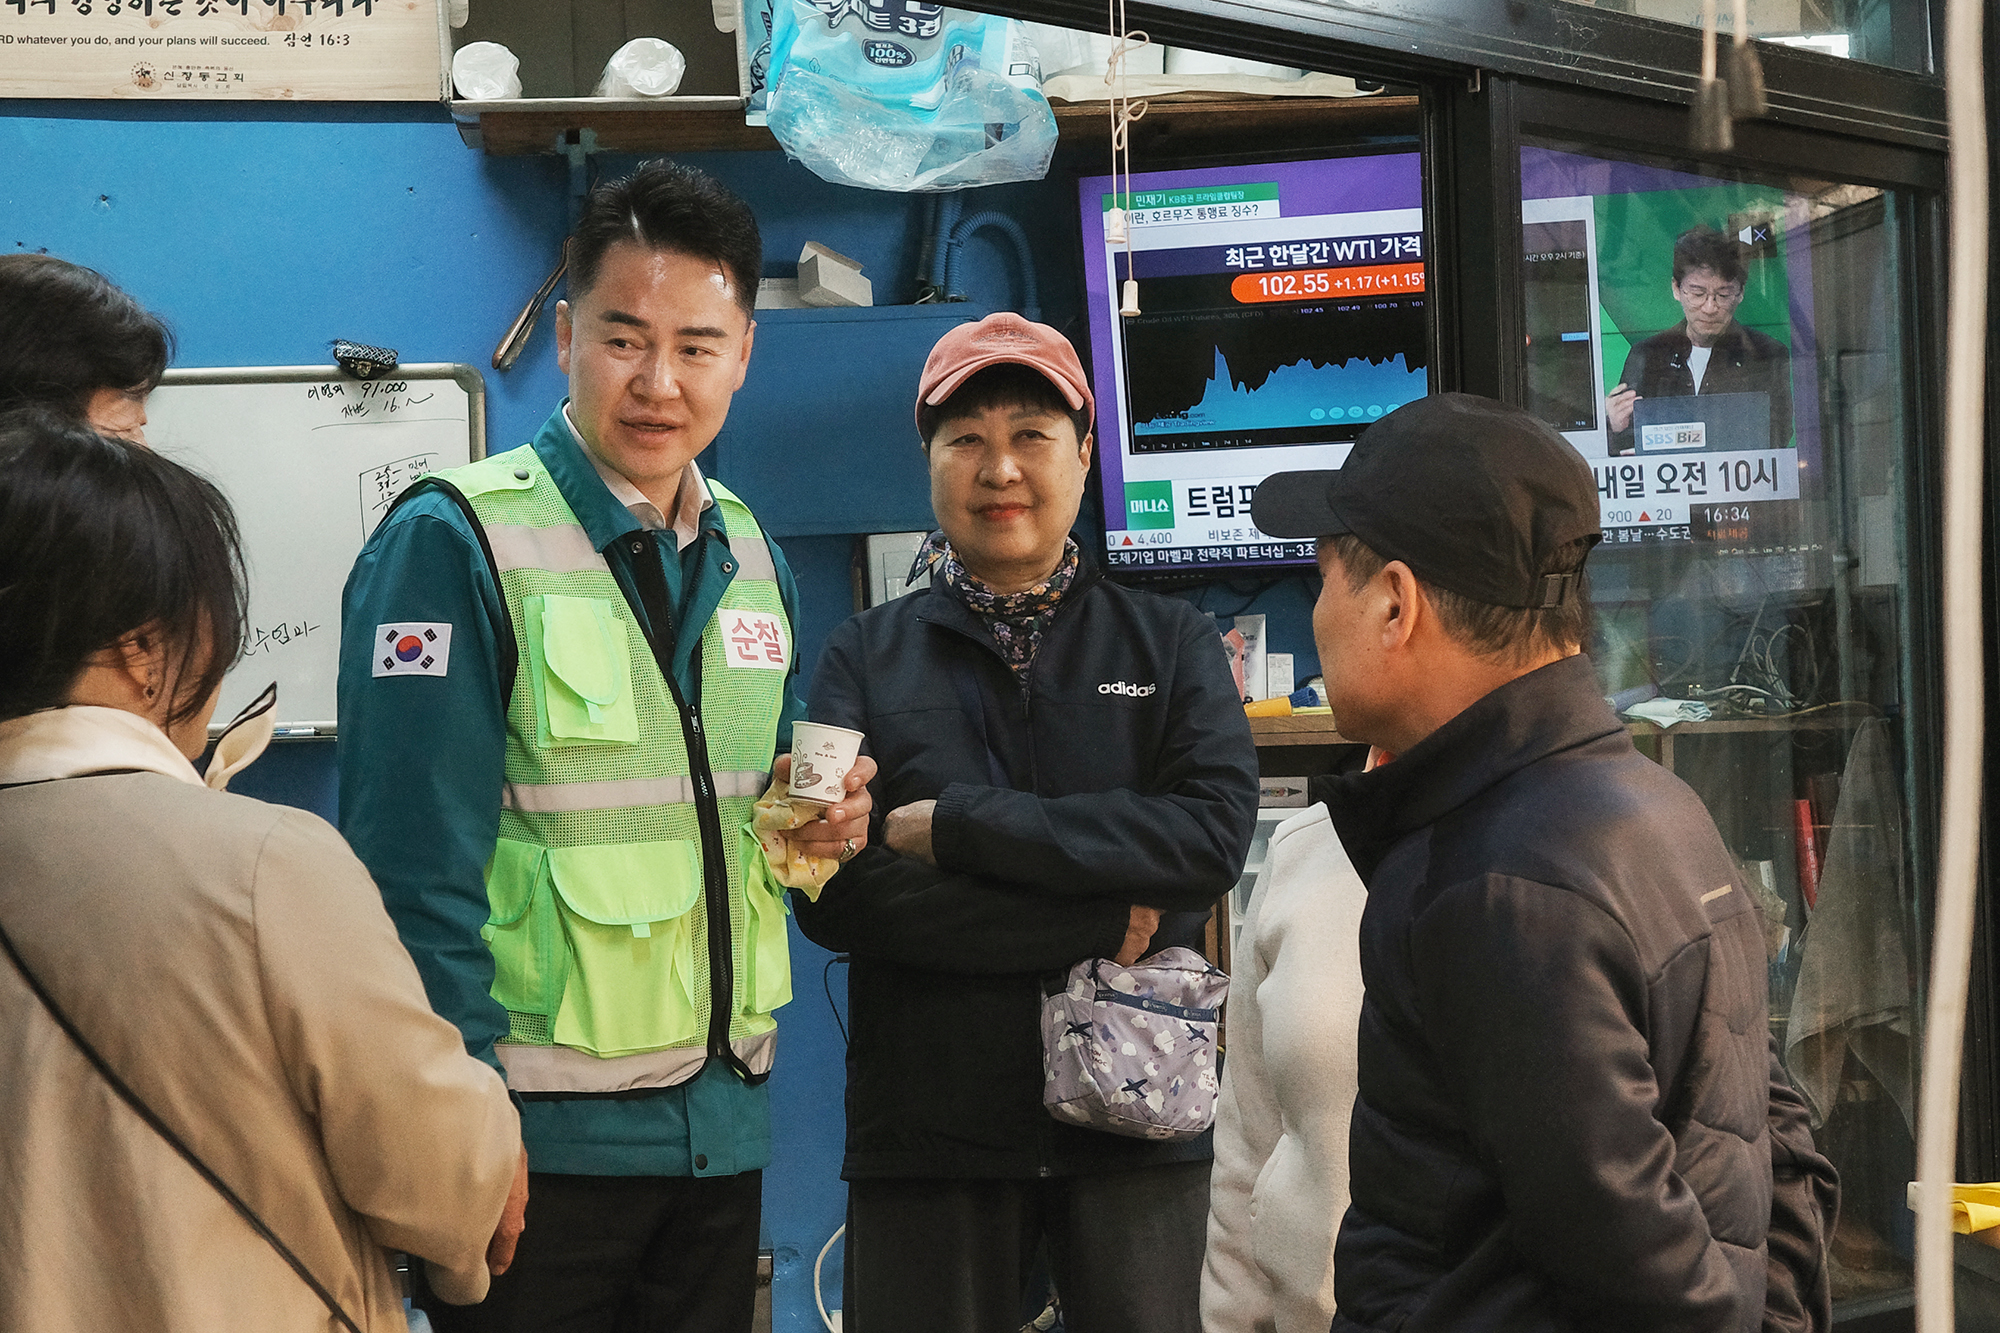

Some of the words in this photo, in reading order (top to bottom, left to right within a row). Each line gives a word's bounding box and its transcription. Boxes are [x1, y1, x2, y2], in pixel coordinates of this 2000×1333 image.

[17, 34, 67, 45] whatever
[71, 36, 91, 47] you
[94, 34, 112, 46] do,
[114, 34, 135, 45] and
[139, 36, 163, 47] your
[167, 35, 196, 47] plans
[199, 35, 218, 45] will
[221, 35, 270, 46] succeed.
[284, 32, 312, 47] 잠언
[320, 34, 350, 46] 16:3
[869, 46, 906, 60] 100%
[1135, 193, 1166, 207] 민재기
[1169, 194, 1194, 204] KB증권
[1152, 209, 1193, 222] 호르무즈
[1197, 206, 1228, 221] 통행료
[1231, 204, 1259, 218] 징수?
[1225, 246, 1266, 269] 최근
[1269, 242, 1330, 266] 한달간
[1332, 239, 1376, 262] WTI
[1381, 235, 1422, 259] 가격
[1523, 254, 1539, 263] 시간
[1540, 252, 1554, 261] 오후
[1555, 252, 1568, 260] 2시
[1259, 273, 1330, 297] 102.55
[1334, 275, 1373, 291] +1.17
[1645, 432, 1674, 446] SBS
[1677, 430, 1701, 444] Biz
[1593, 463, 1646, 500] 내일
[1656, 460, 1708, 495] 오전
[1717, 456, 1779, 492] 10시
[1607, 510, 1632, 523] 900
[1656, 508, 1673, 521] 20
[1704, 506, 1751, 523] 16:34
[1138, 532, 1173, 545] 4,400
[1208, 528, 1244, 542] 비보존
[1108, 551, 1154, 565] 도체기업
[1158, 549, 1193, 563] 마벨과
[1197, 547, 1233, 562] 전략적
[731, 617, 784, 664] 순찰
[1097, 680, 1156, 697] adidas
